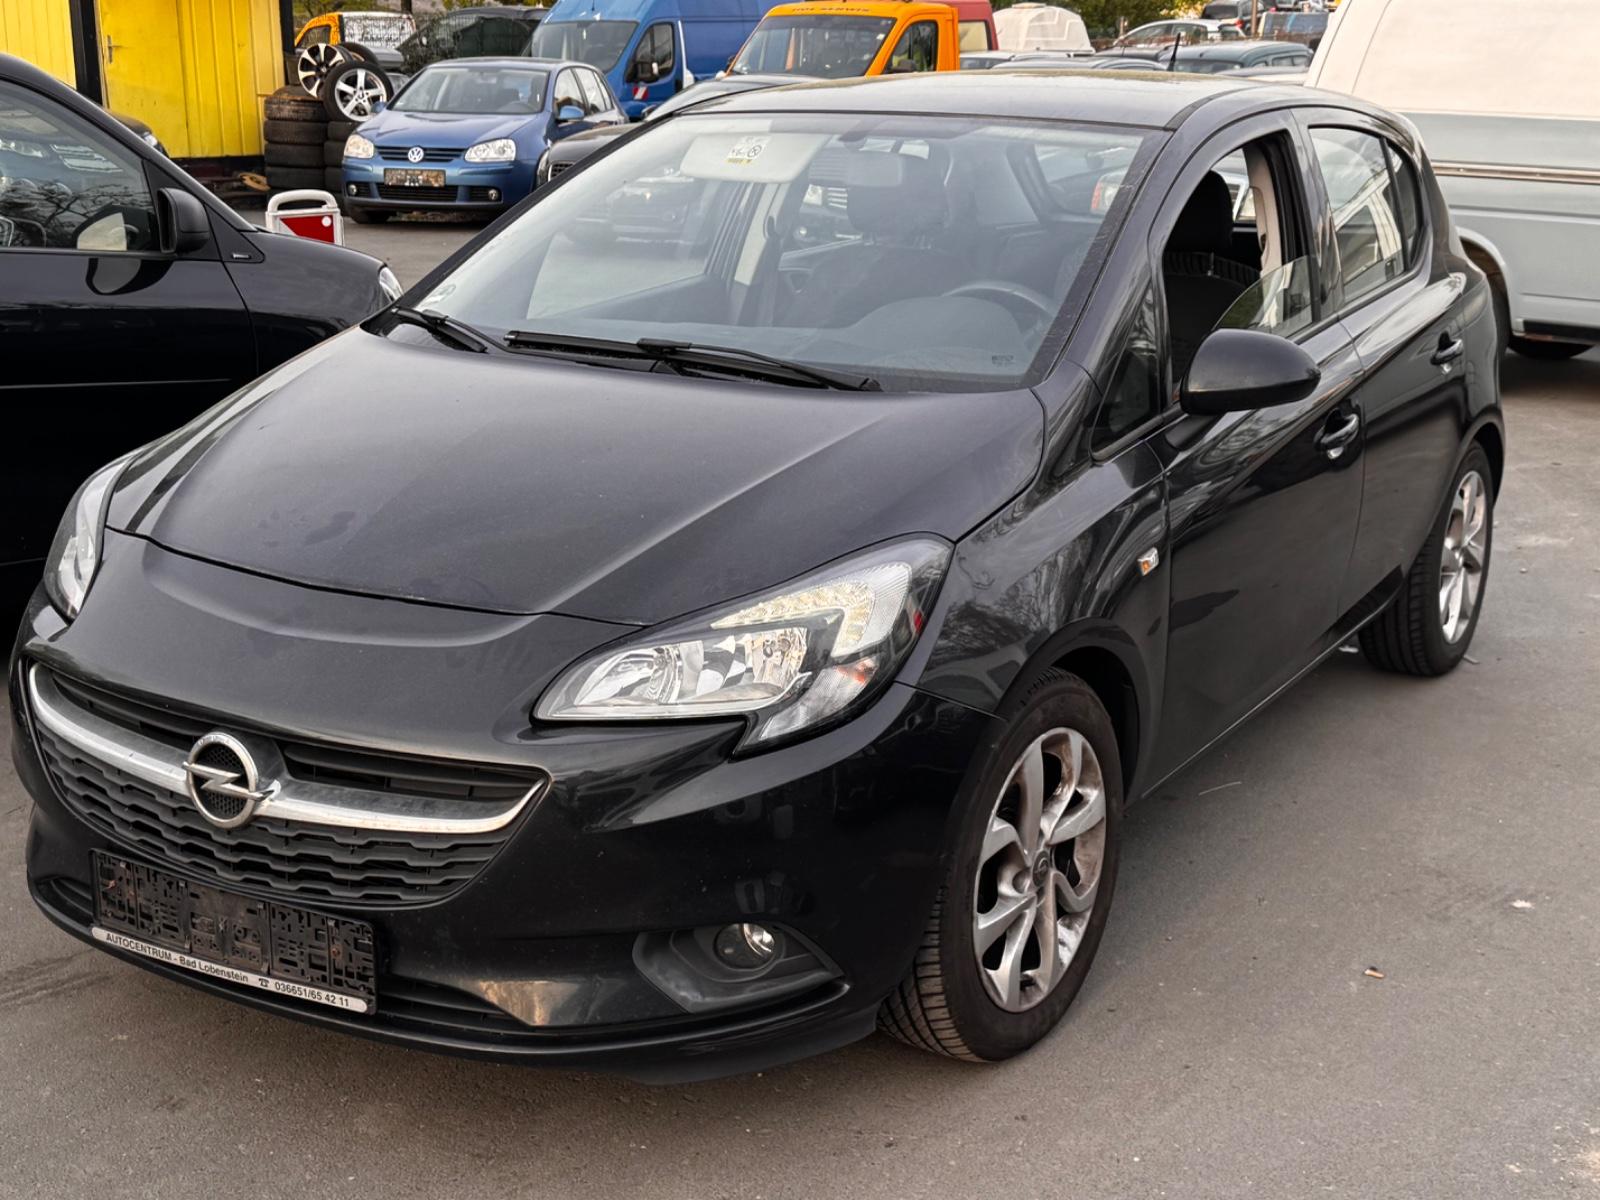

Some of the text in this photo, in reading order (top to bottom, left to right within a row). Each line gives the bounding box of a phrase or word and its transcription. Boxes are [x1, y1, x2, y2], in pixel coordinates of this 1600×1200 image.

[106, 933, 172, 961] AUTOCENTRUM
[179, 955, 197, 969] Bad
[199, 961, 249, 982] Lobenstein
[274, 981, 322, 1001] 036651/65
[324, 994, 337, 1004] 42
[339, 997, 349, 1007] 11
